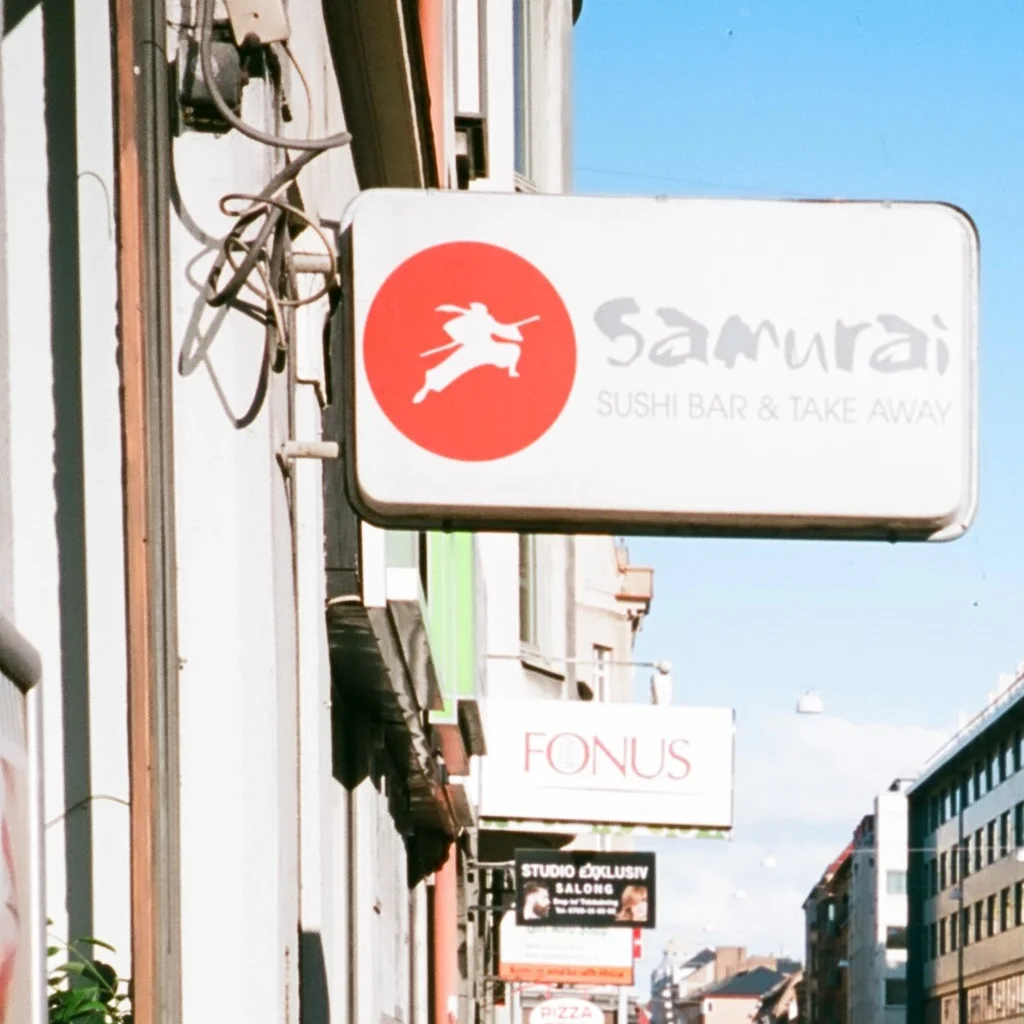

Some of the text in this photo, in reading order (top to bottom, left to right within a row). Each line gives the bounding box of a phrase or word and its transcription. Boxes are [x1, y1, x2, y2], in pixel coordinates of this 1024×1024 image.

[597, 390, 952, 426] SUSHI BAR & TAKE AWAY
[524, 732, 692, 781] FONUS
[521, 863, 576, 879] STUDIO
[555, 882, 614, 895] SALONG
[541, 1005, 593, 1020] PIZZA
